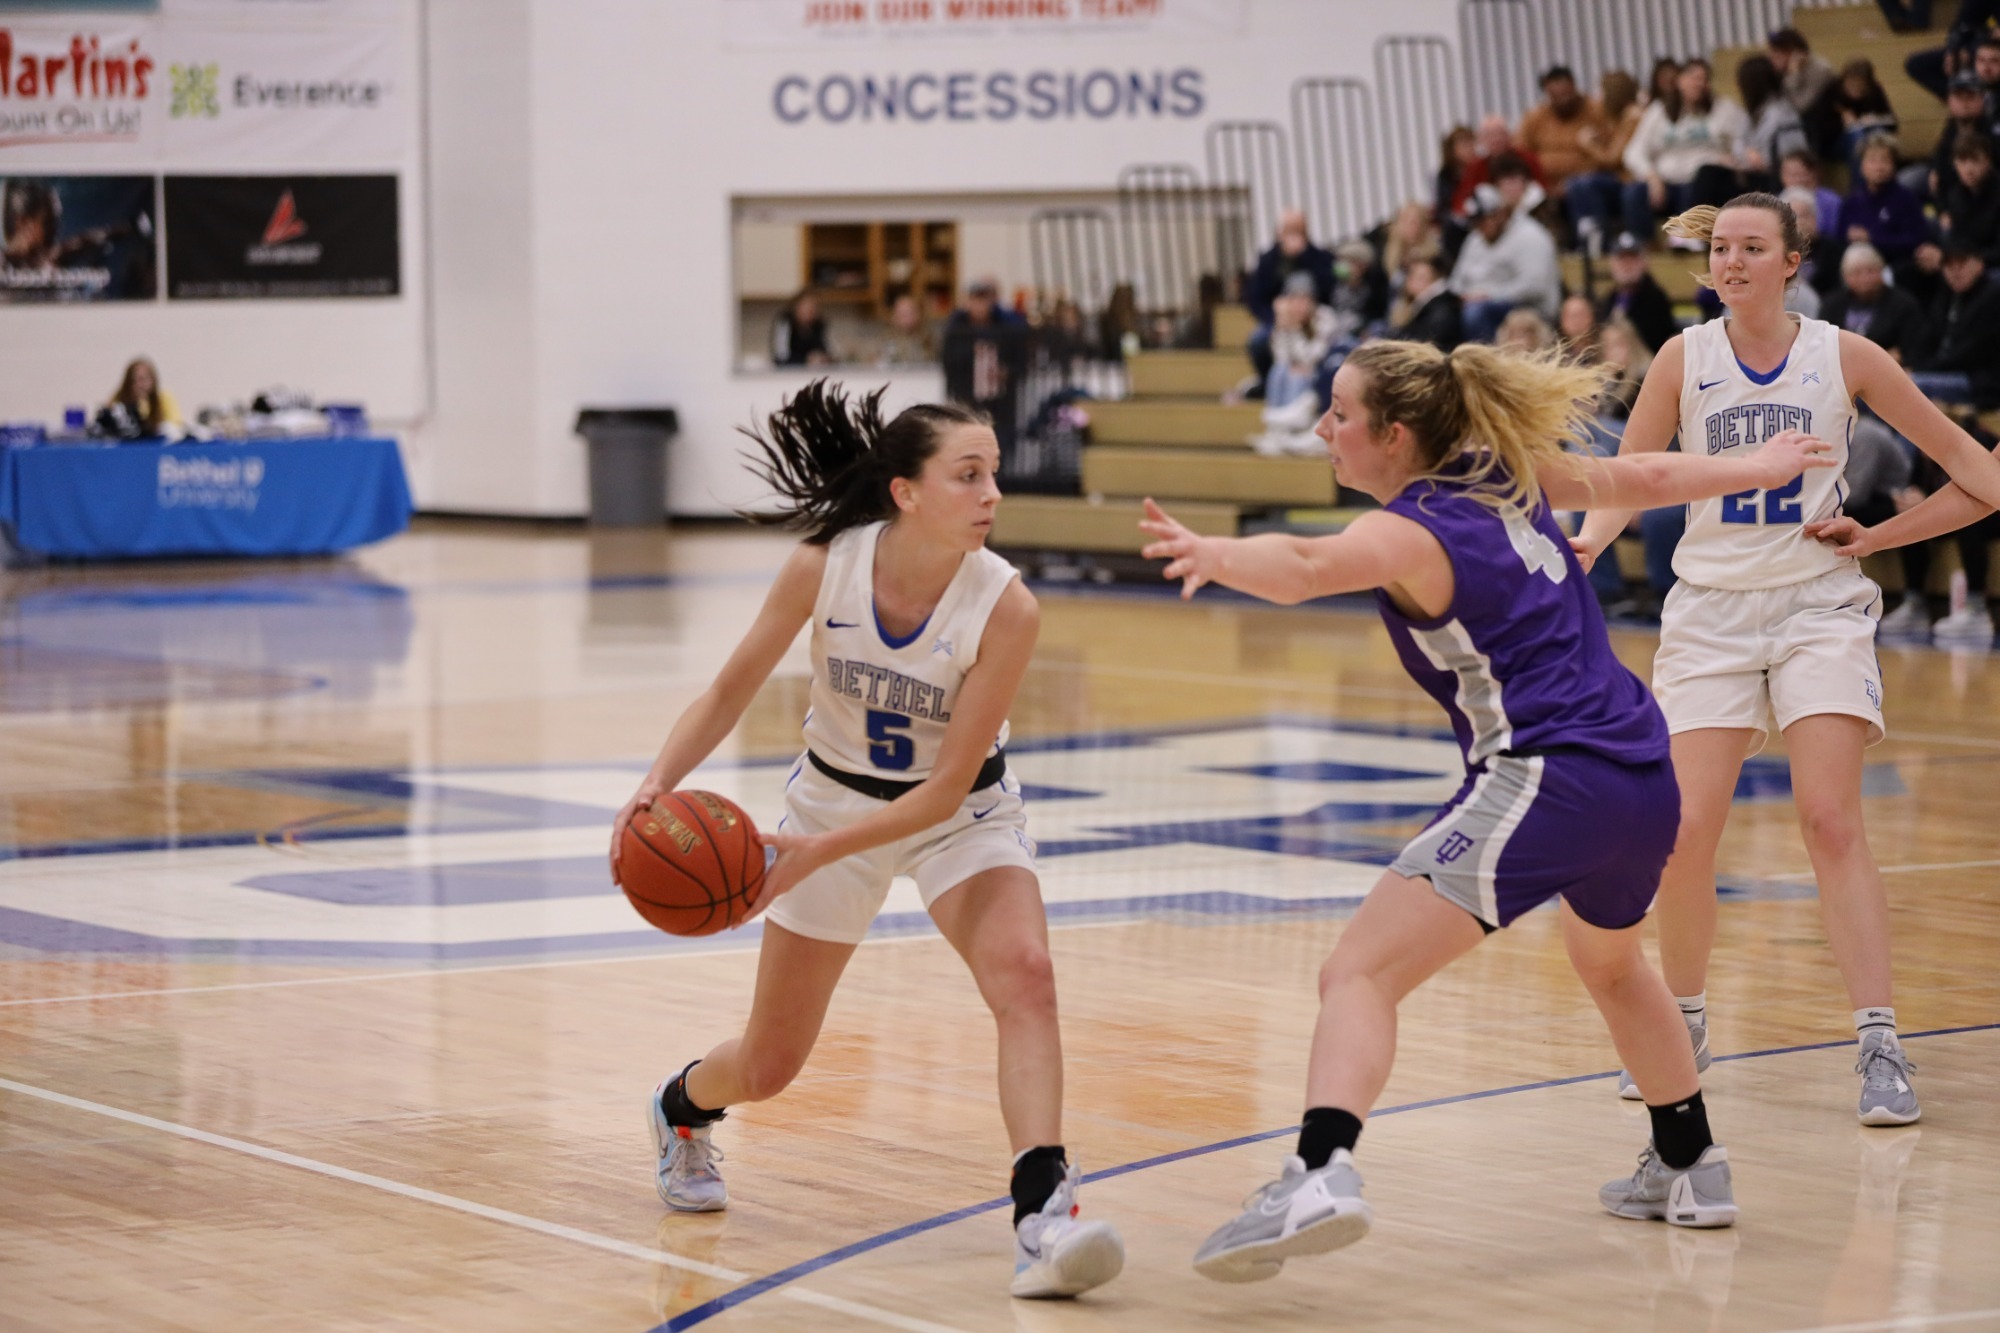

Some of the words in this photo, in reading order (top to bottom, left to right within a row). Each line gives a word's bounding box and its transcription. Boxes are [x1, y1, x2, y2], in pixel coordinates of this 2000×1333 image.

[233, 74, 381, 108] Everence
[772, 66, 1206, 124] CONCESSIONS
[1498, 501, 1569, 585] 4
[827, 656, 951, 723] BETHEL
[865, 707, 915, 772] 5
